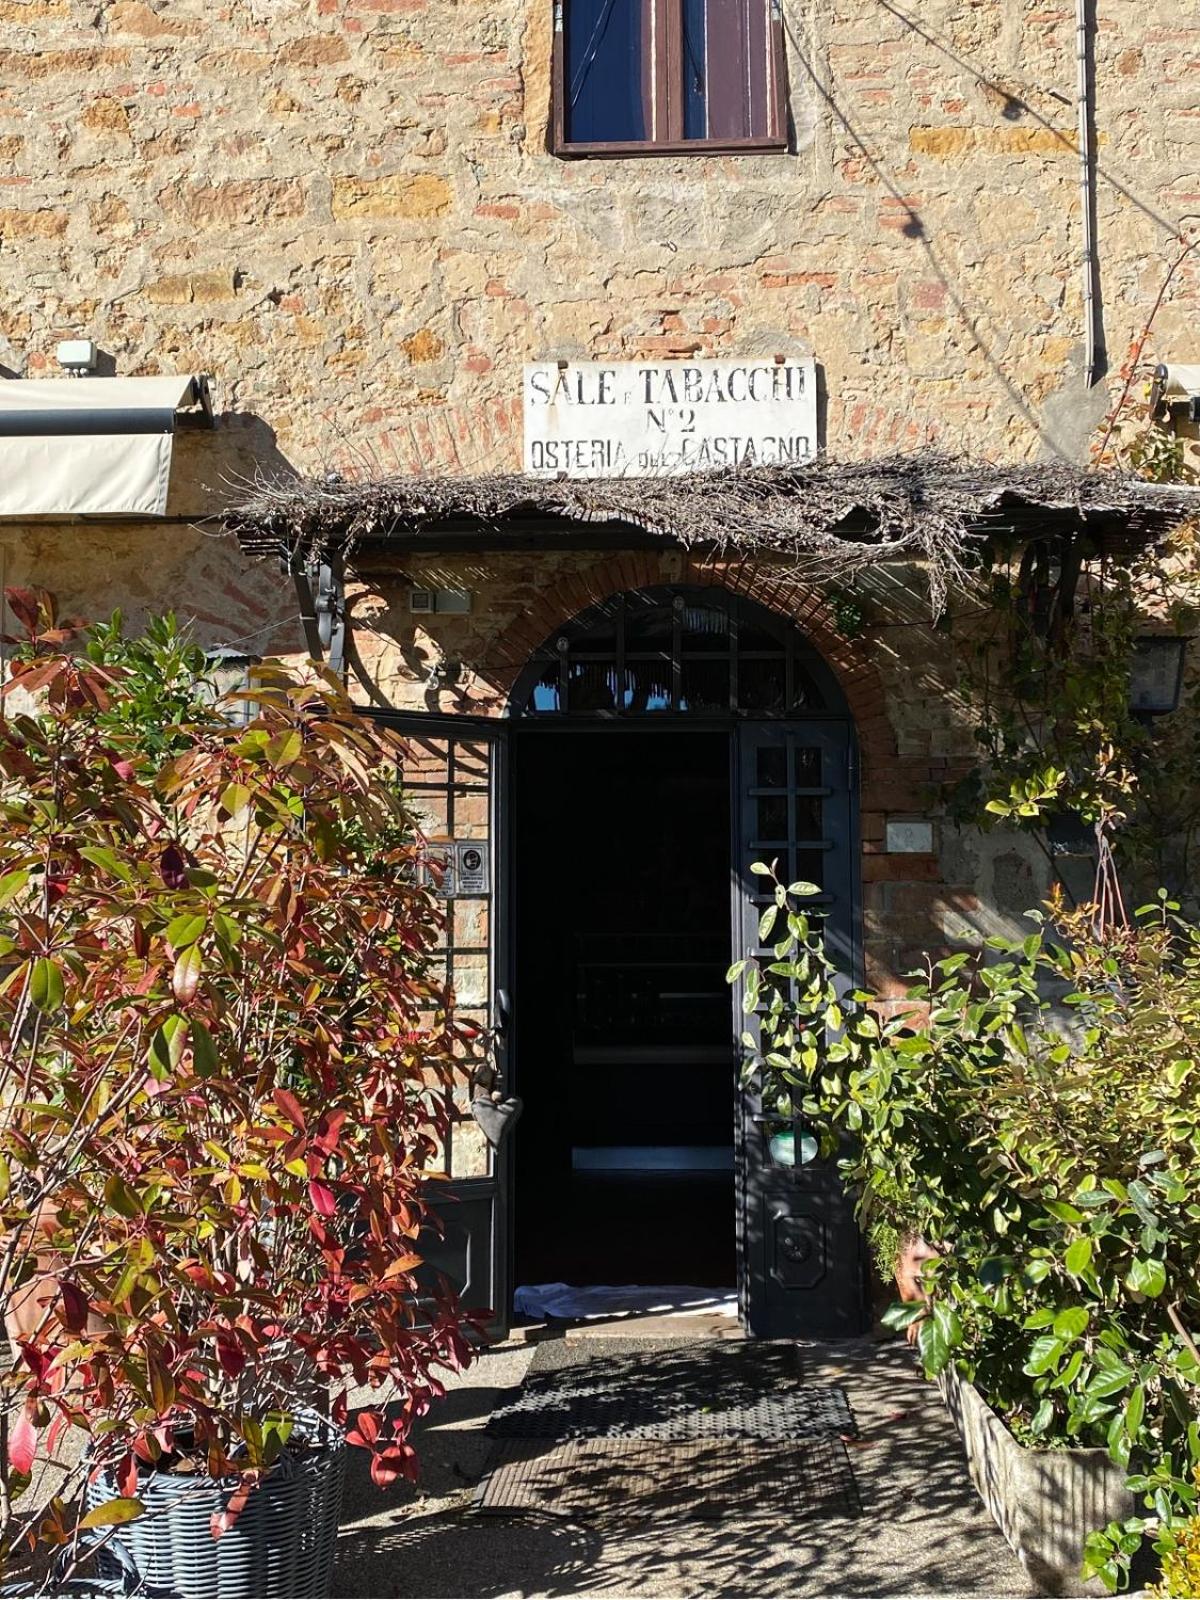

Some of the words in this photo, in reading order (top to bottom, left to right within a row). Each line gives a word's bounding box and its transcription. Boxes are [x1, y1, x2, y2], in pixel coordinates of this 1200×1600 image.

[530, 369, 616, 405] SALE
[638, 366, 807, 404] TABACCHI
[531, 439, 627, 469] OSTERIA
[681, 435, 810, 467] CASTAGNO
